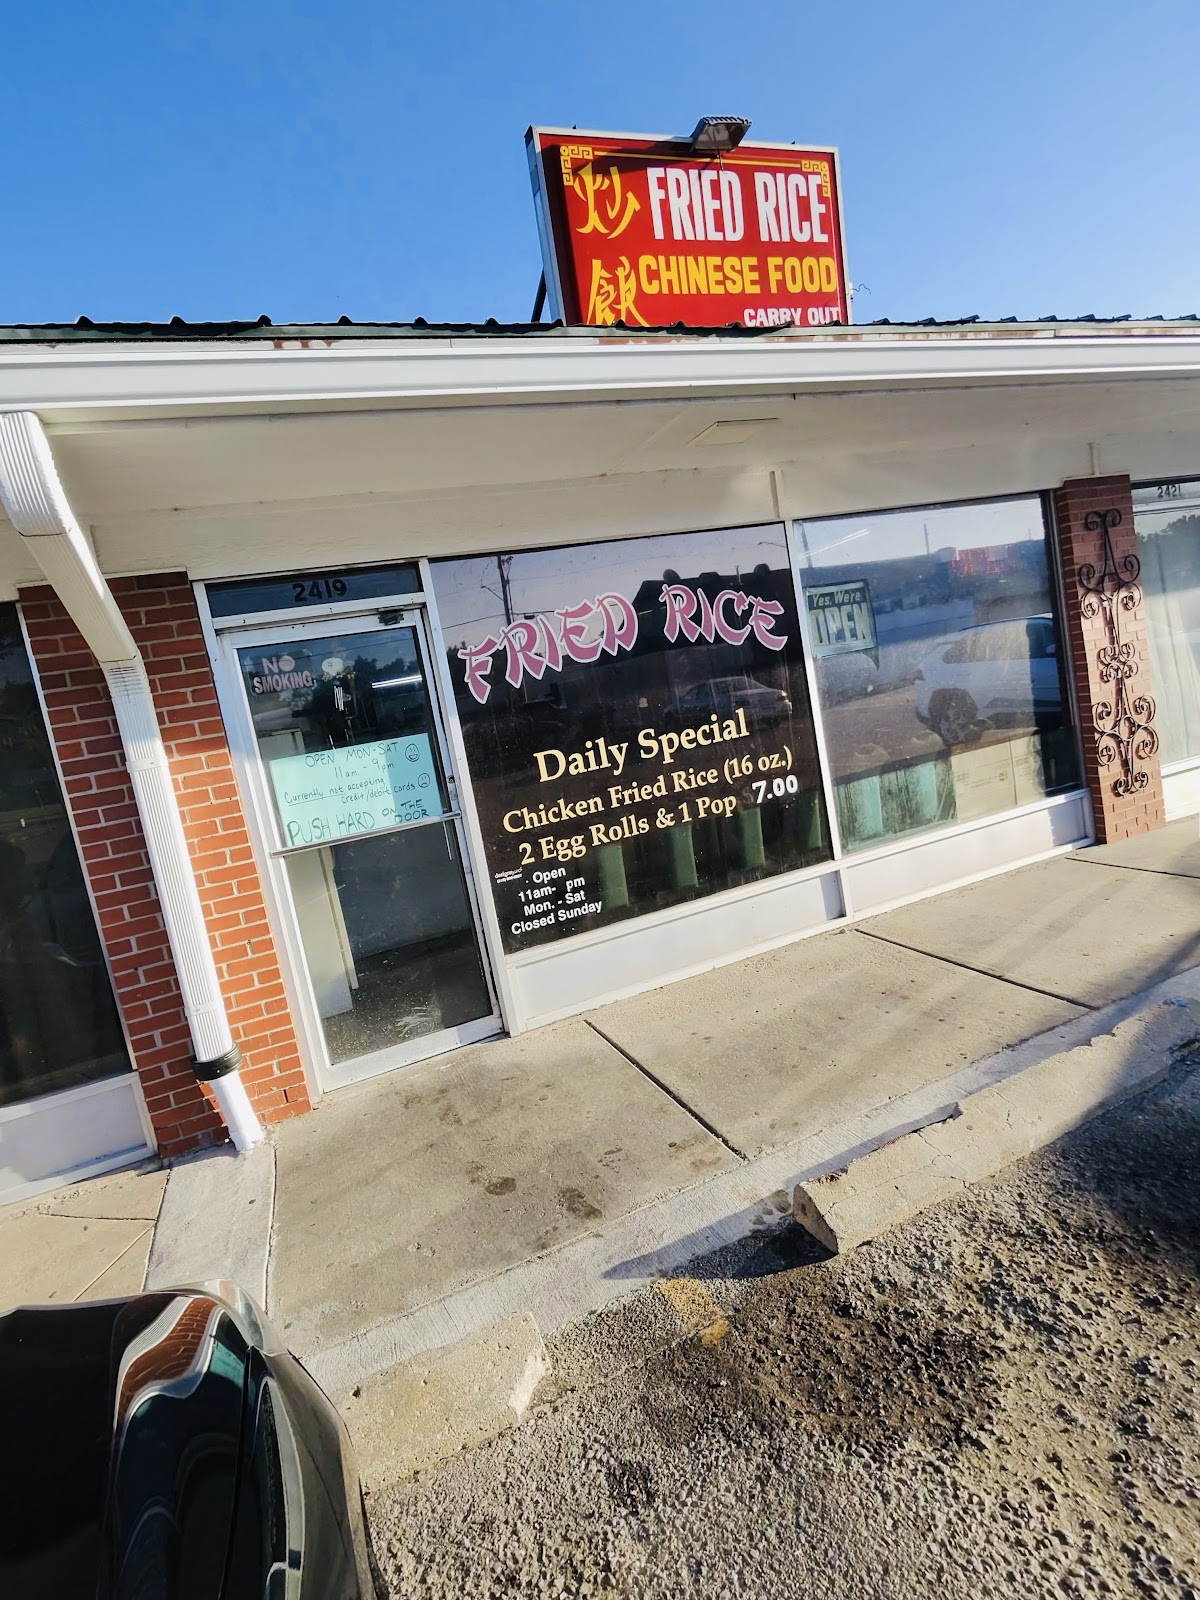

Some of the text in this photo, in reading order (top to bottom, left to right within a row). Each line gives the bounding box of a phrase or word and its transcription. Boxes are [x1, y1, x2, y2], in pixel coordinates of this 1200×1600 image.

[646, 166, 829, 243] FRIED RICE
[638, 254, 837, 294] CHINESE FOOD
[743, 306, 839, 328] CARRY OUT
[1156, 484, 1182, 499] 2421
[292, 578, 347, 602] 2419
[834, 589, 861, 604] We're
[809, 602, 872, 646] OPEN
[457, 584, 789, 705] FRIED RICE
[253, 670, 313, 693] SMOKING
[533, 708, 750, 783] Daily Special
[305, 752, 334, 768] OPEN
[284, 777, 386, 804] Currently not accepting
[502, 745, 793, 834] Chicken Fried Rice (16 oz.)
[394, 809, 430, 824] DOOR
[400, 798, 424, 811] THE
[286, 807, 397, 847] PUSH HARD ON
[519, 774, 799, 866] 2 Egg Rolls & 1 Pop 7.00
[532, 867, 566, 884] Open
[566, 876, 586, 892] pm
[523, 901, 555, 916] Mon.
[565, 890, 586, 904] Sat
[511, 900, 603, 935] Closed Sunday
